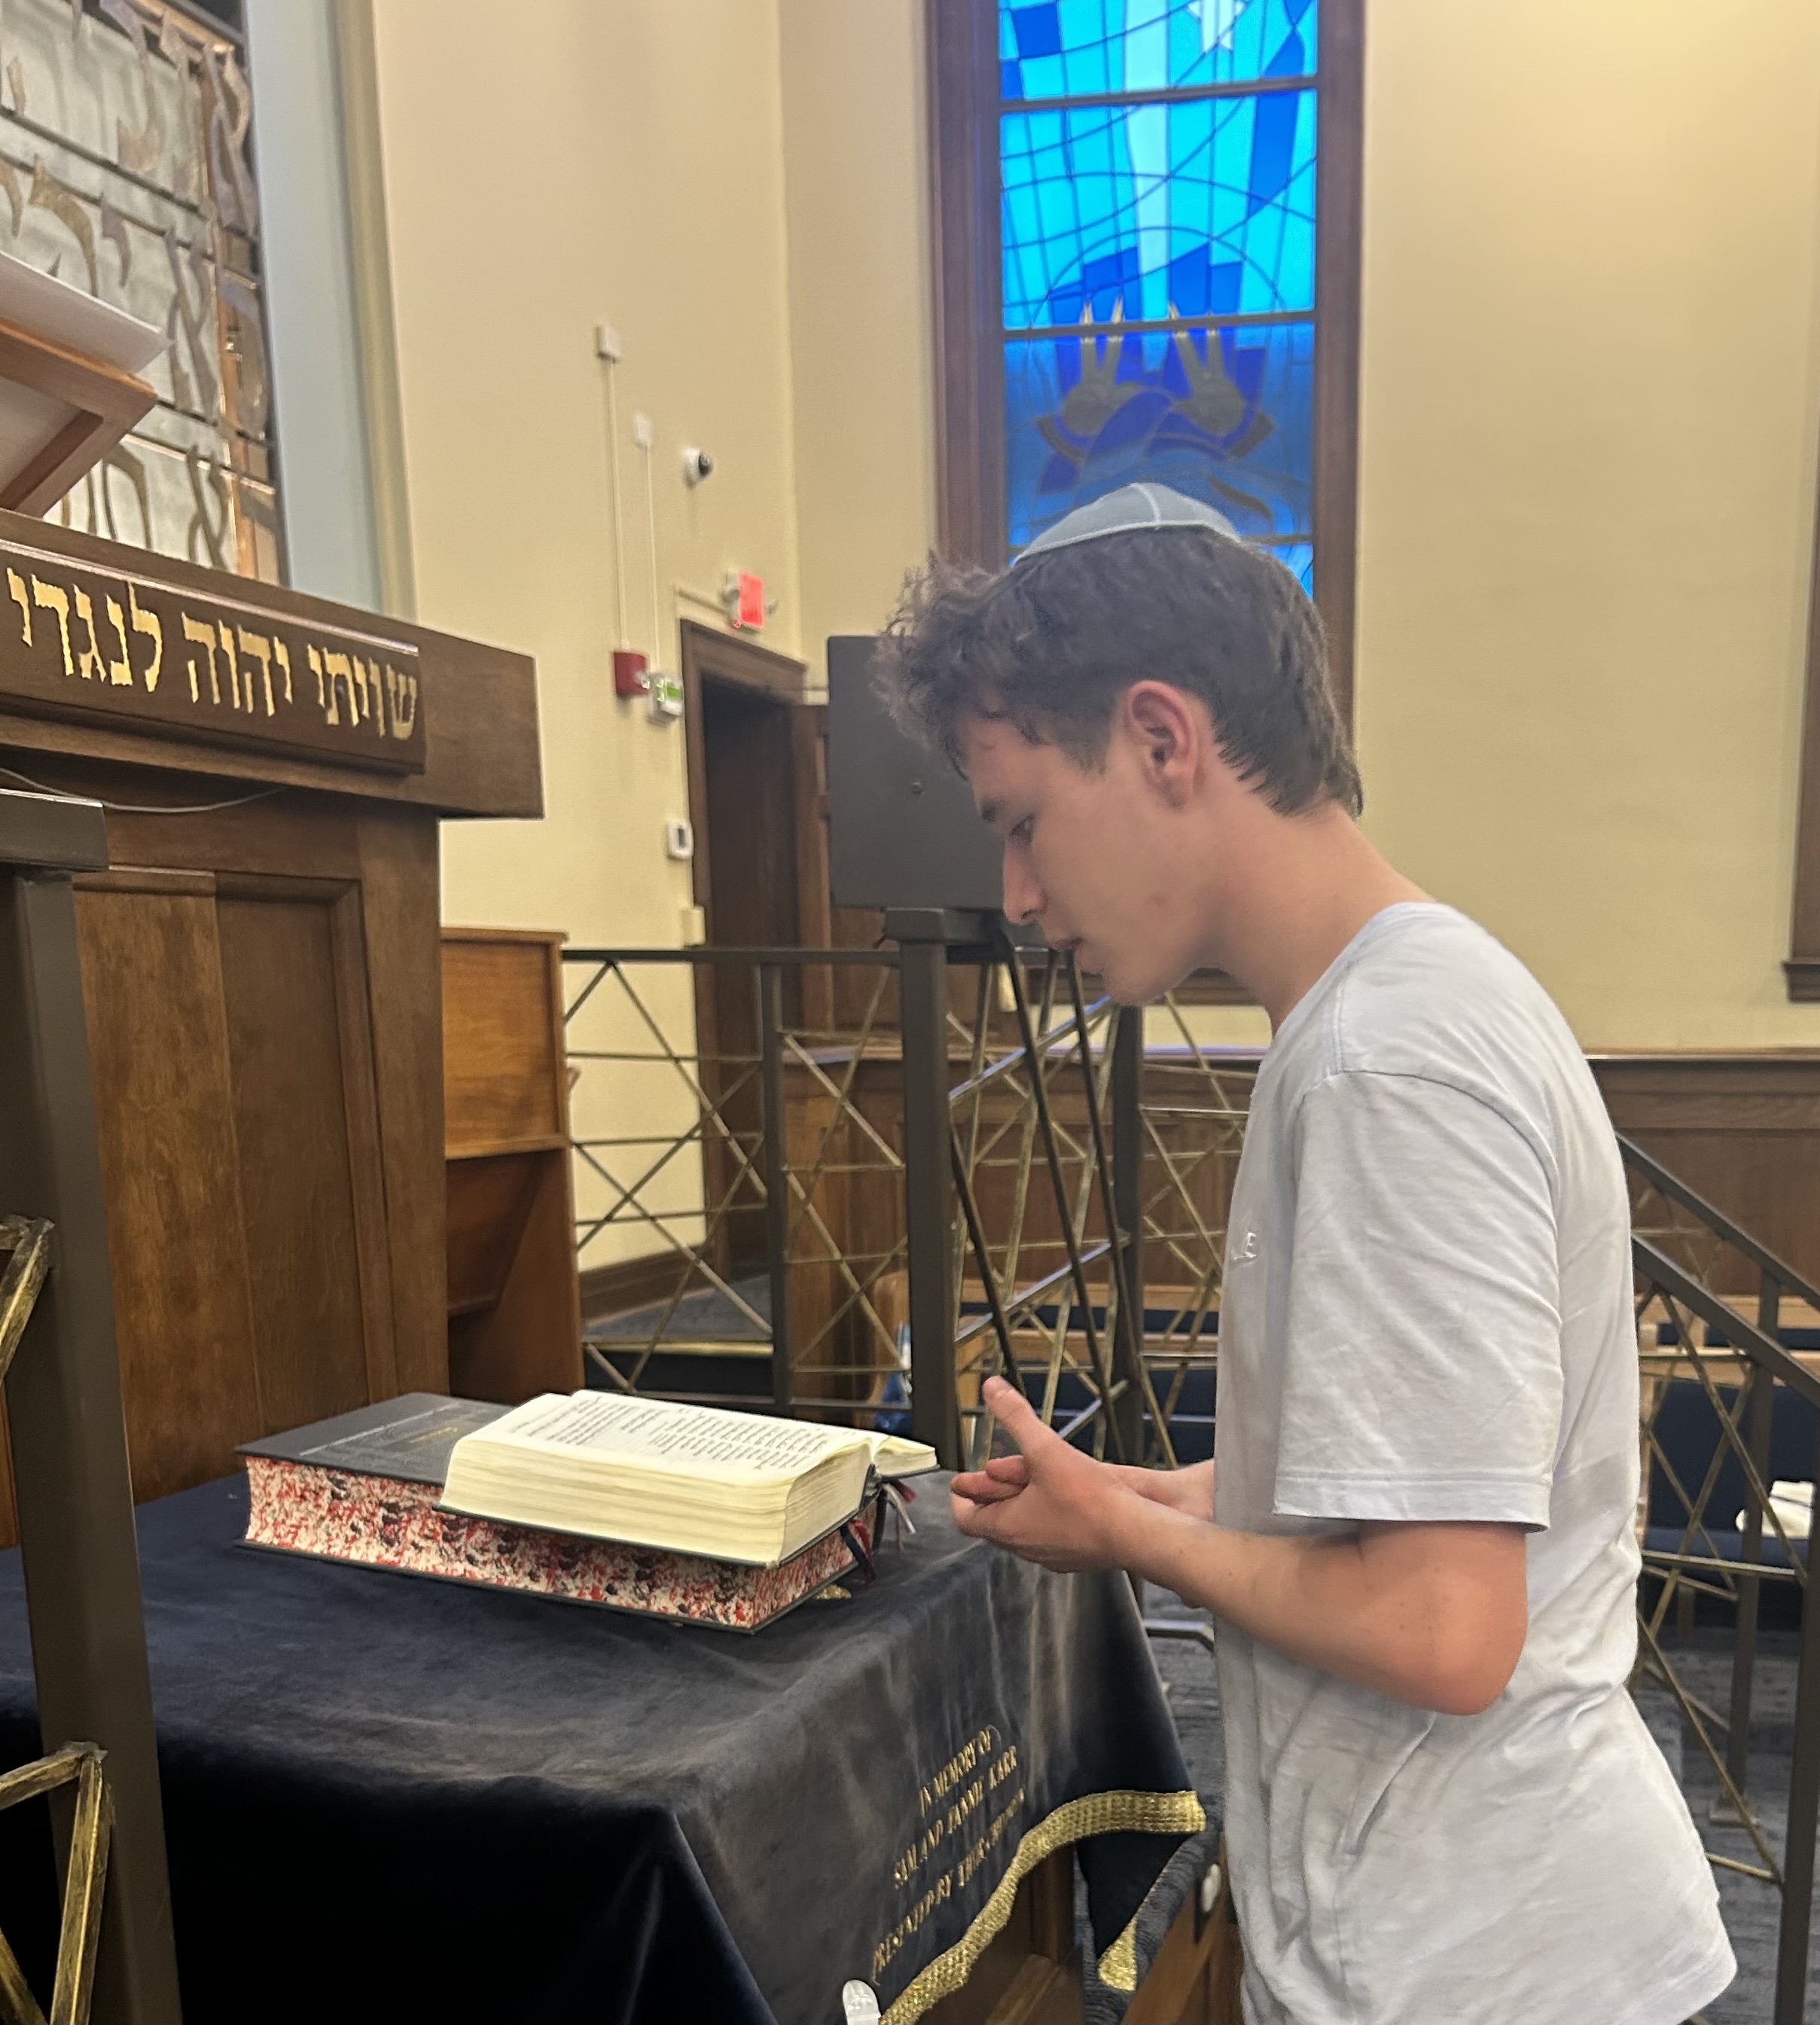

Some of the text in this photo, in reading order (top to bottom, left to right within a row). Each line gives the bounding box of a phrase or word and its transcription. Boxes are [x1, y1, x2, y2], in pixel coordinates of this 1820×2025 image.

[6, 566, 418, 740] שויתי יהוה לנגדי
[933, 1739, 977, 1801] MEMORY
